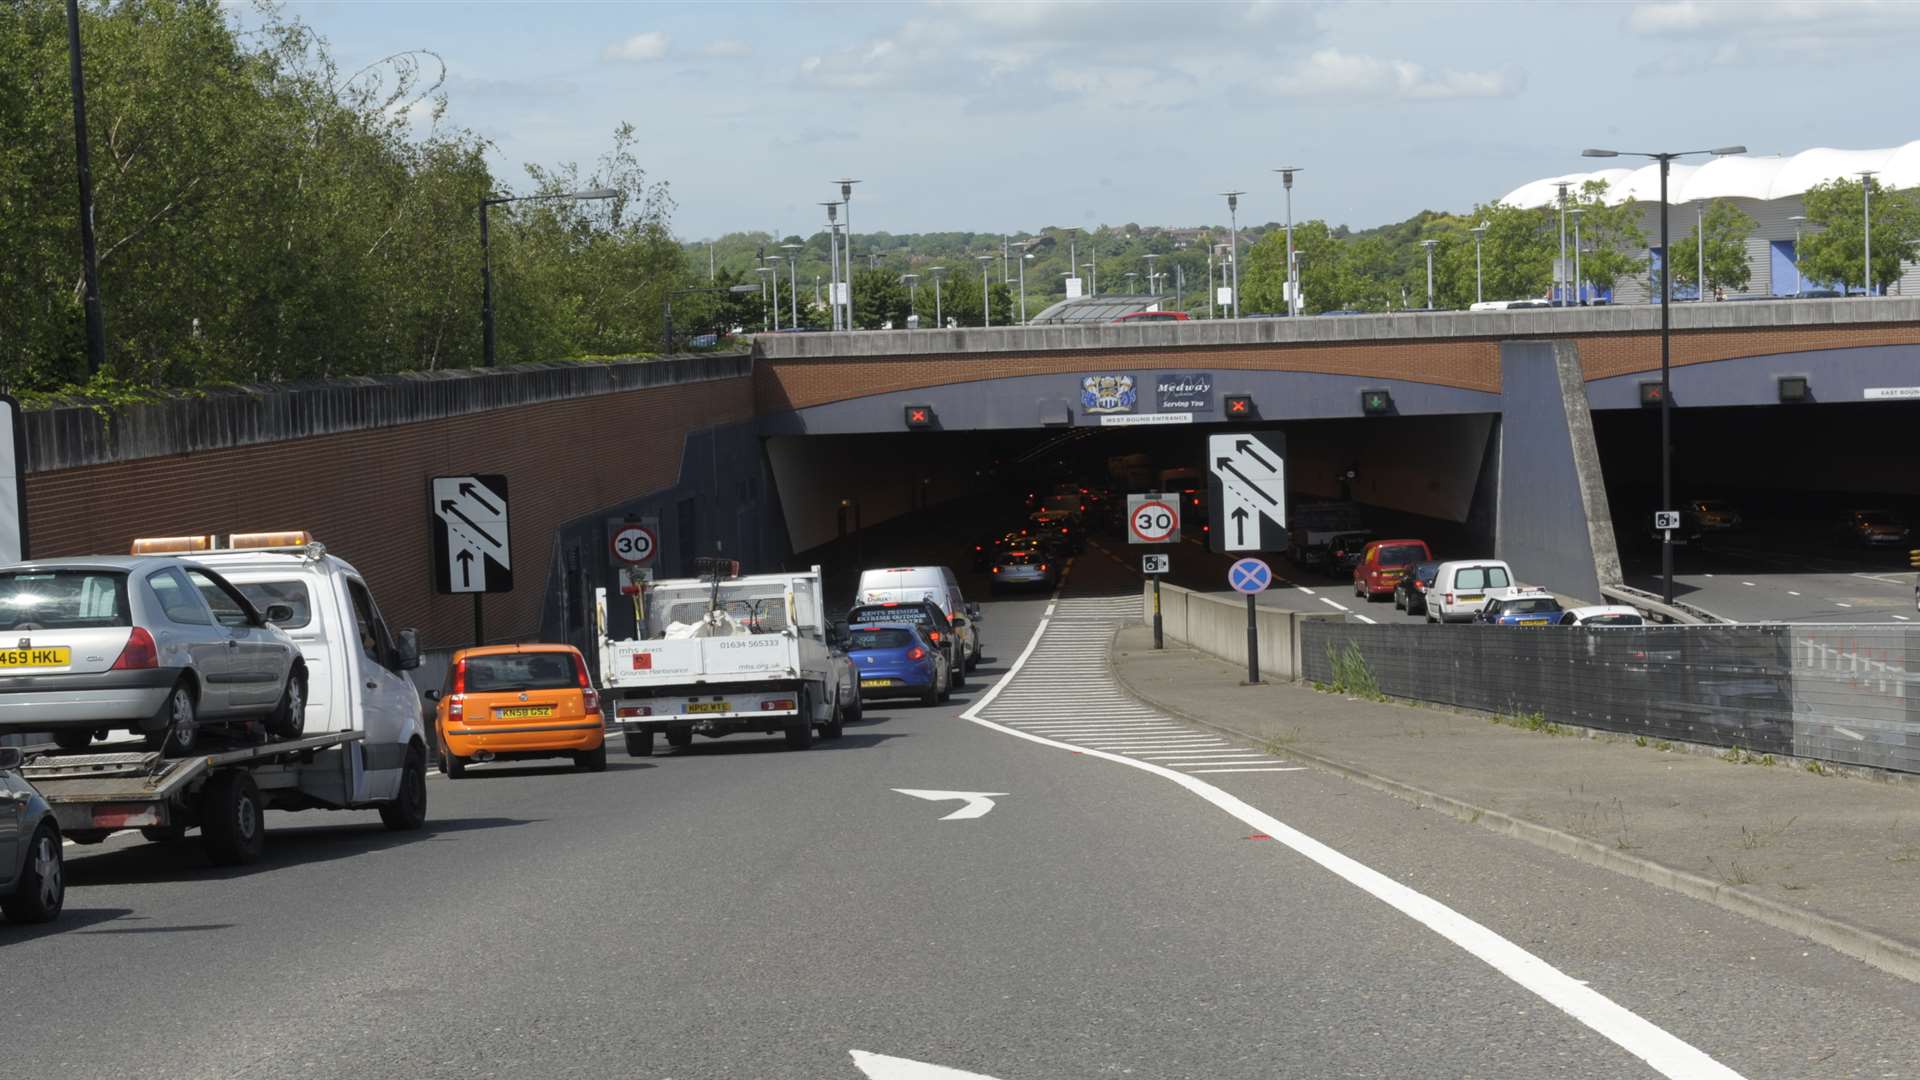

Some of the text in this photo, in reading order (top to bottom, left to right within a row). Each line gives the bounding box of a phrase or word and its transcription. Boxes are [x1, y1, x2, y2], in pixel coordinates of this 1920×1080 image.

[1158, 382, 1210, 392] Medway
[1163, 400, 1189, 408] Serving
[1138, 513, 1171, 529] 30
[618, 536, 650, 553] 30
[720, 639, 779, 649] 01634 565333
[0, 650, 63, 664] 469 HKL
